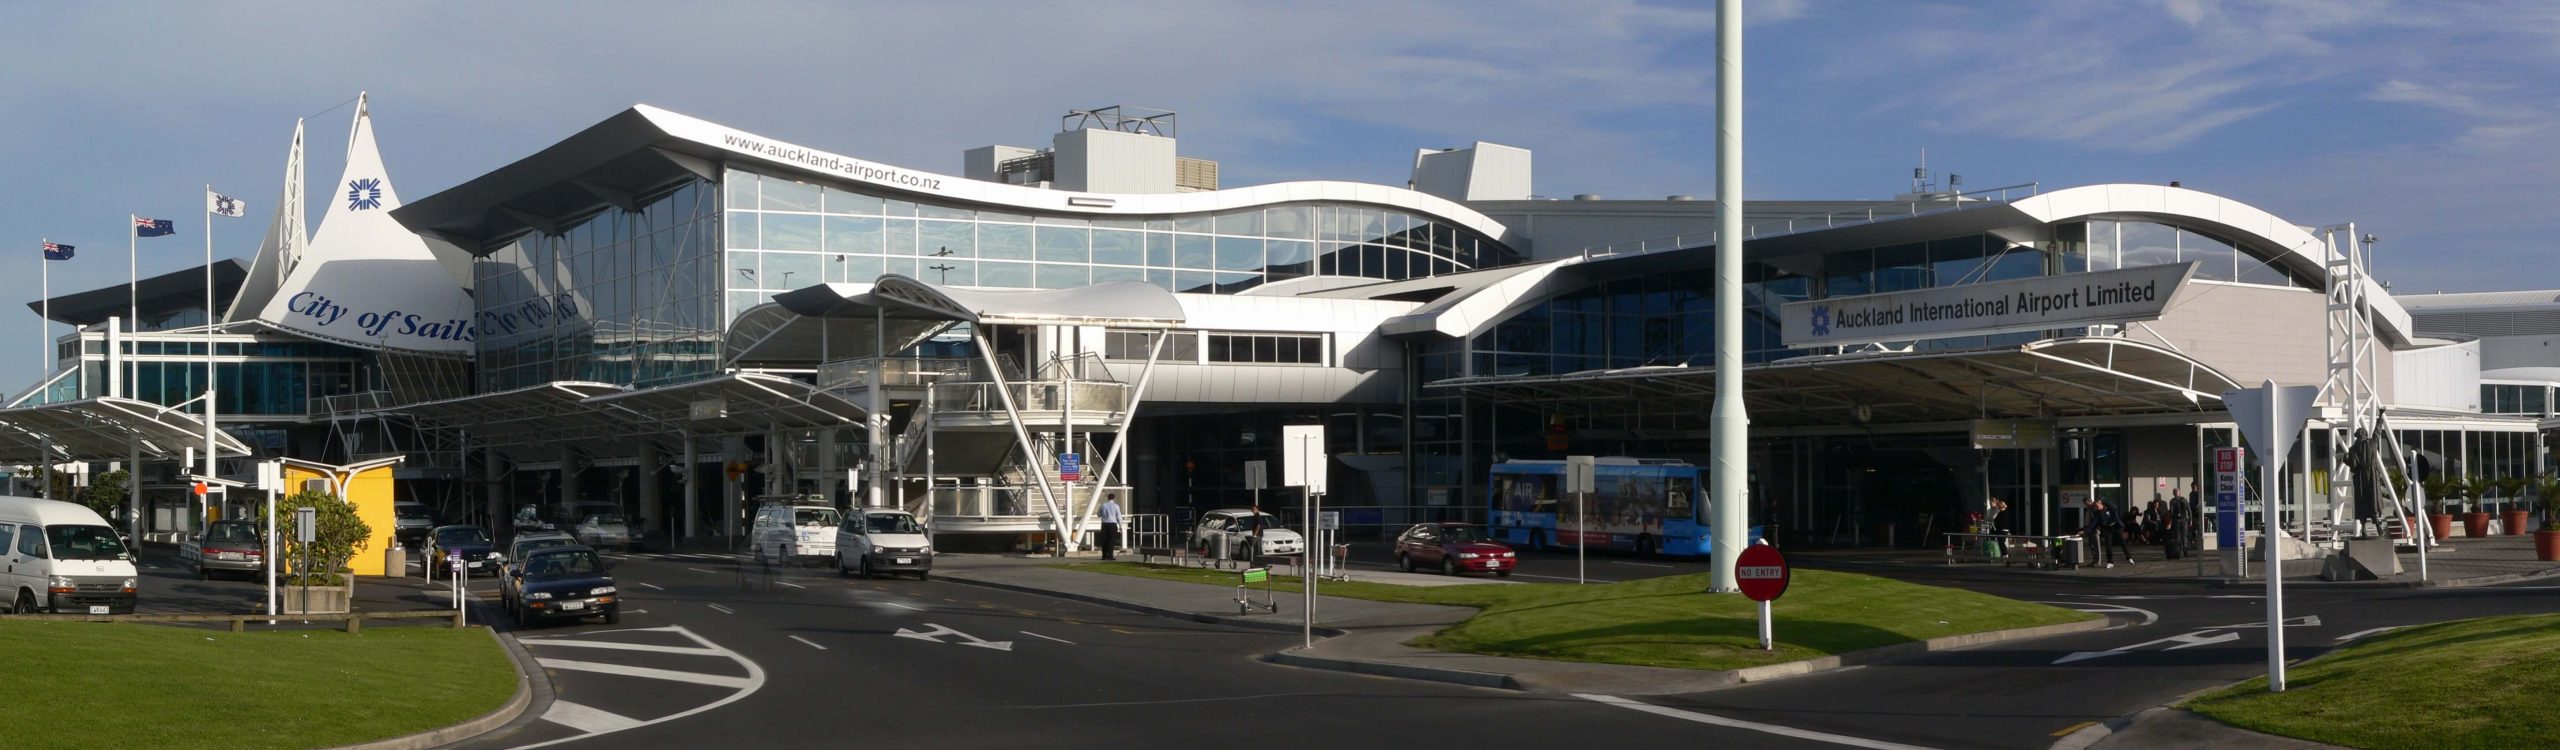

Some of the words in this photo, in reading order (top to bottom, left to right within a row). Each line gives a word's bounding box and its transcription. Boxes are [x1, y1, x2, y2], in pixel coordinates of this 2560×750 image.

[724, 133, 941, 190] www.auckland-airport.co.nz
[1836, 303, 1903, 329] Auckland
[1910, 294, 2009, 323] International
[2016, 290, 2079, 317] Airport
[2086, 280, 2155, 307] Limited
[288, 291, 348, 326] City
[357, 310, 401, 337] of
[398, 314, 475, 343] Sails
[2221, 451, 2232, 460] BUS
[2220, 462, 2233, 470] STOP
[2220, 474, 2233, 482] Keep
[1514, 481, 1534, 501] AIR
[1741, 568, 1751, 577] NO
[1755, 568, 1779, 577] ENTRY
